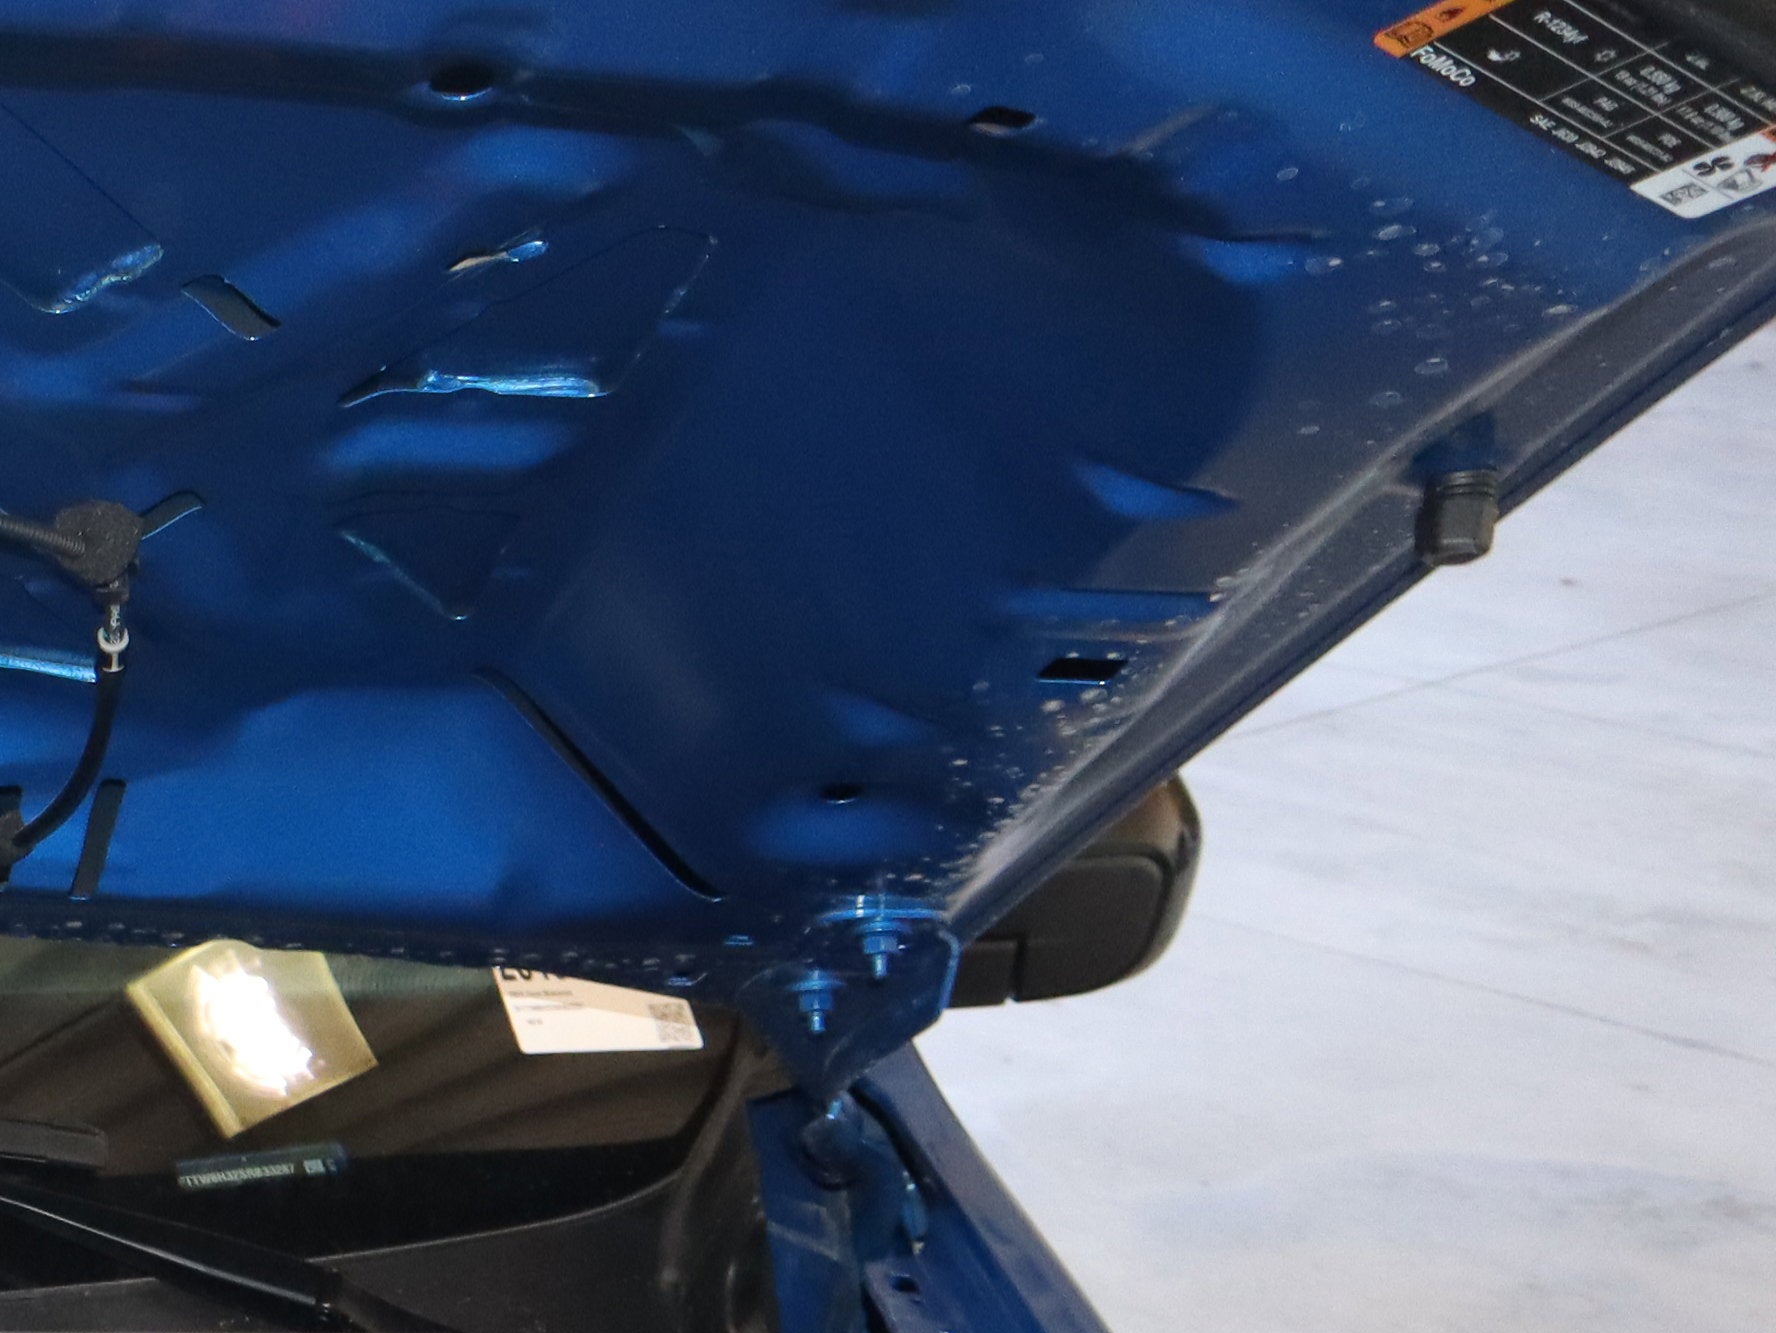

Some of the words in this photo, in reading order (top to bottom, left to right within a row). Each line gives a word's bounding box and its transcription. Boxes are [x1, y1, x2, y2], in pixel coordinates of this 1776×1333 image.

[1533, 10, 1589, 44] R-1234yf
[1409, 45, 1476, 87] FoMoCo
[1530, 113, 1556, 130] SAE
